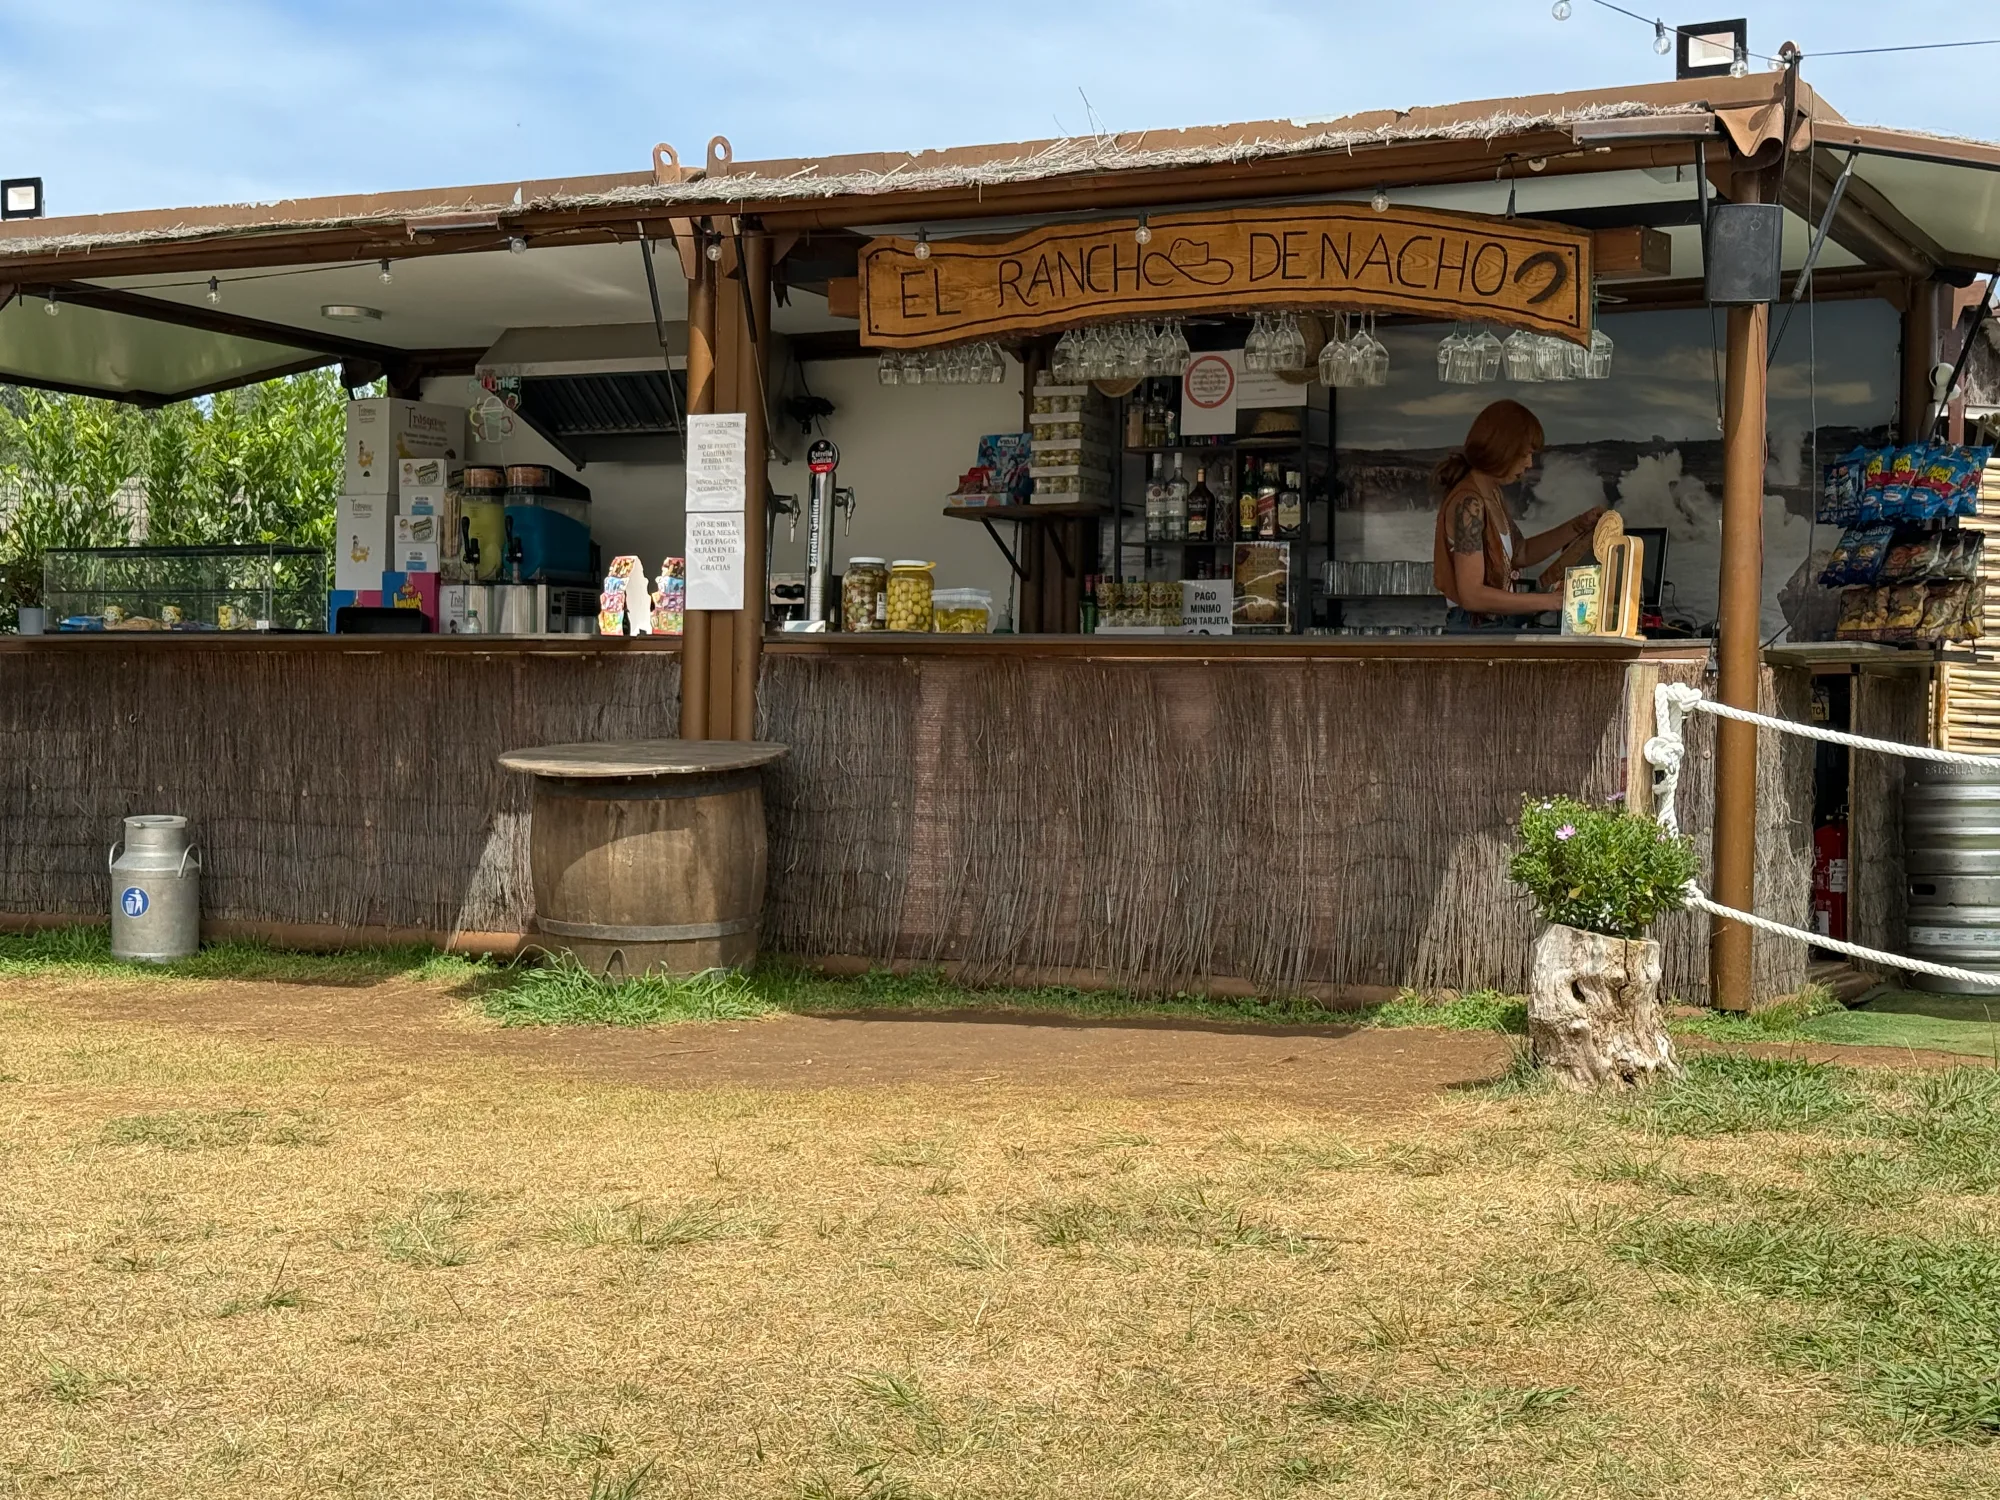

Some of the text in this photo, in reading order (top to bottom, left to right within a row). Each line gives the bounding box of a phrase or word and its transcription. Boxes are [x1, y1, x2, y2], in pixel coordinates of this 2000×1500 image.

[900, 268, 962, 319] EL
[1249, 231, 1308, 282] DE
[1320, 231, 1509, 297] NACHO
[811, 450, 833, 460] Estrella
[695, 520, 737, 528] NO SE SIRVE
[810, 499, 820, 567] Estrella Galicia
[1571, 577, 1597, 590] COCTEL
[1194, 592, 1217, 601] PAGO
[1190, 604, 1221, 614] MINIMO
[1182, 616, 1230, 626] CON TARJETA
[1924, 764, 1974, 776] ESTRELLA
